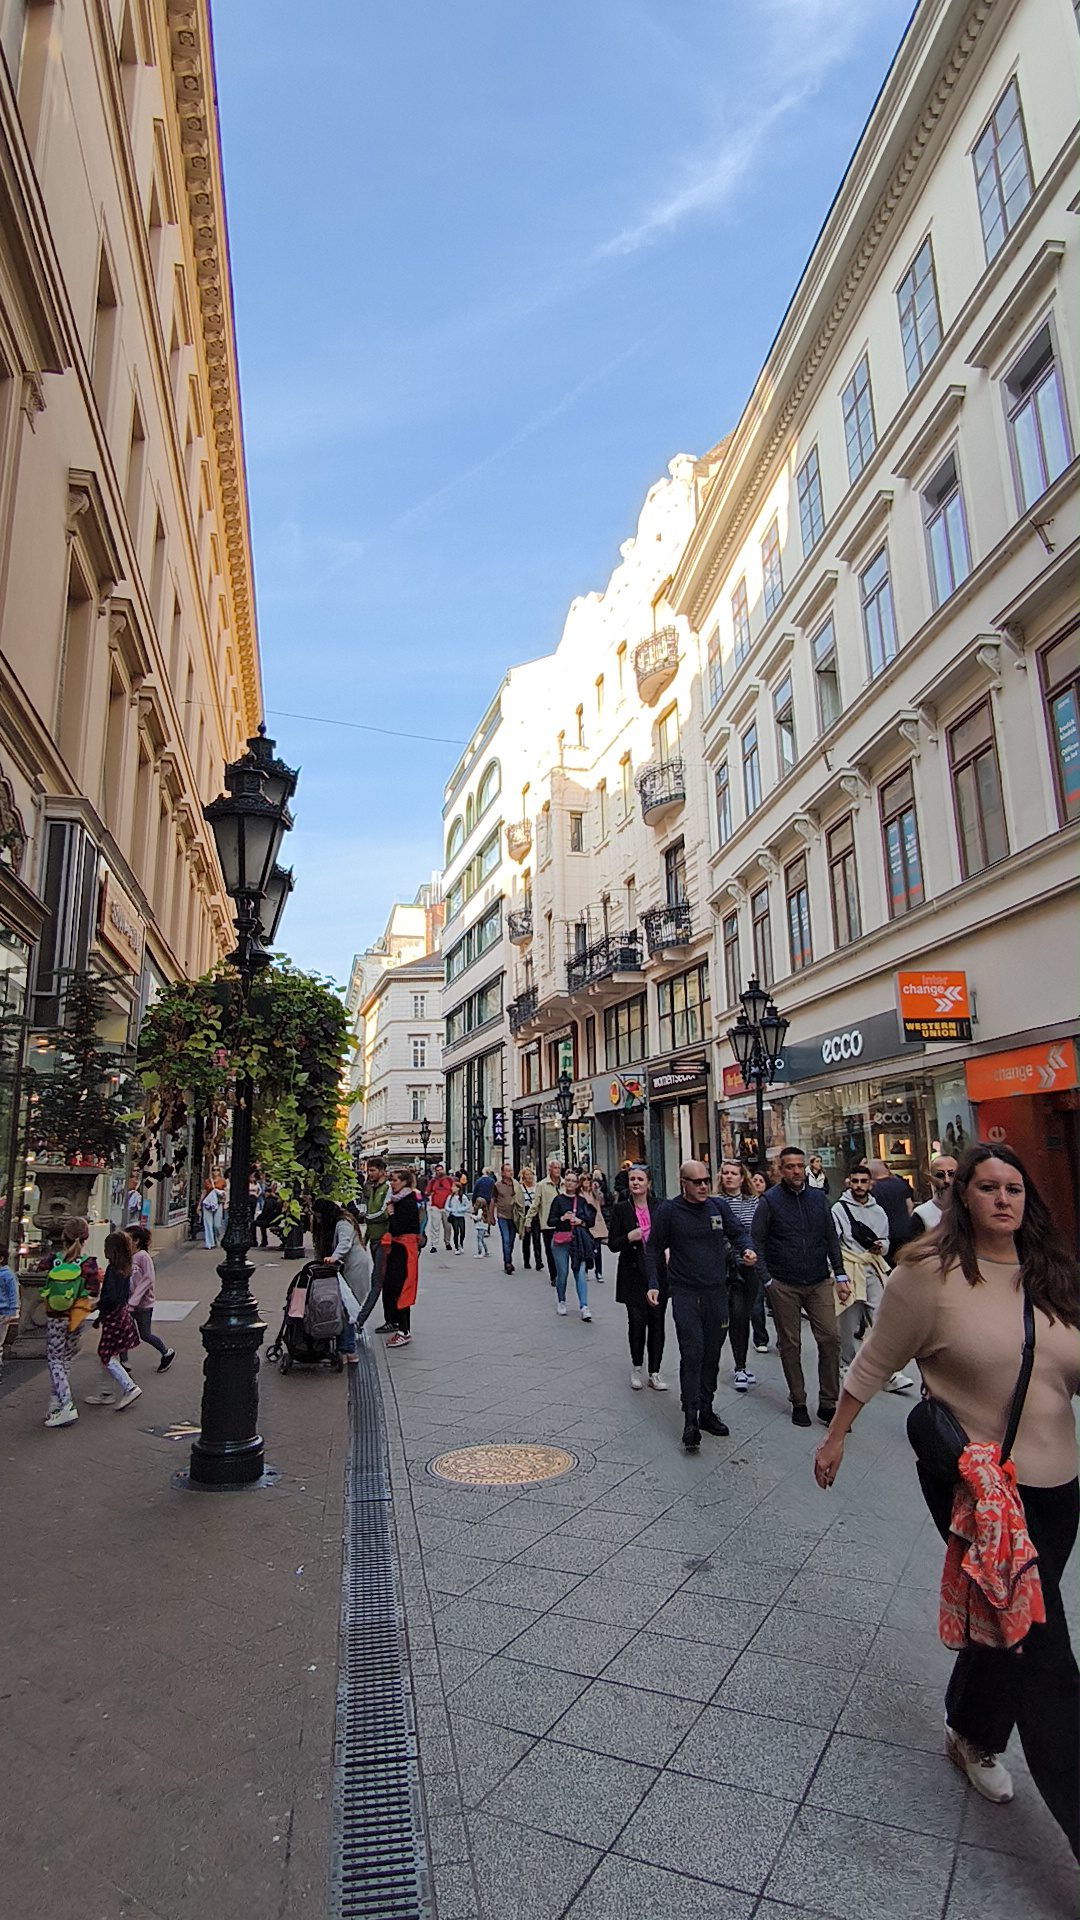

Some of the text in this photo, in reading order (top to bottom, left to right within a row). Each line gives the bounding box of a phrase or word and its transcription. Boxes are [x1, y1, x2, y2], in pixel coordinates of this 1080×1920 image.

[903, 984, 944, 997] change
[905, 1022, 956, 1030] WESTERN
[822, 1030, 862, 1064] ecco
[994, 1064, 1033, 1081] change
[873, 1111, 911, 1125] ecco
[494, 1112, 503, 1141] ZARA
